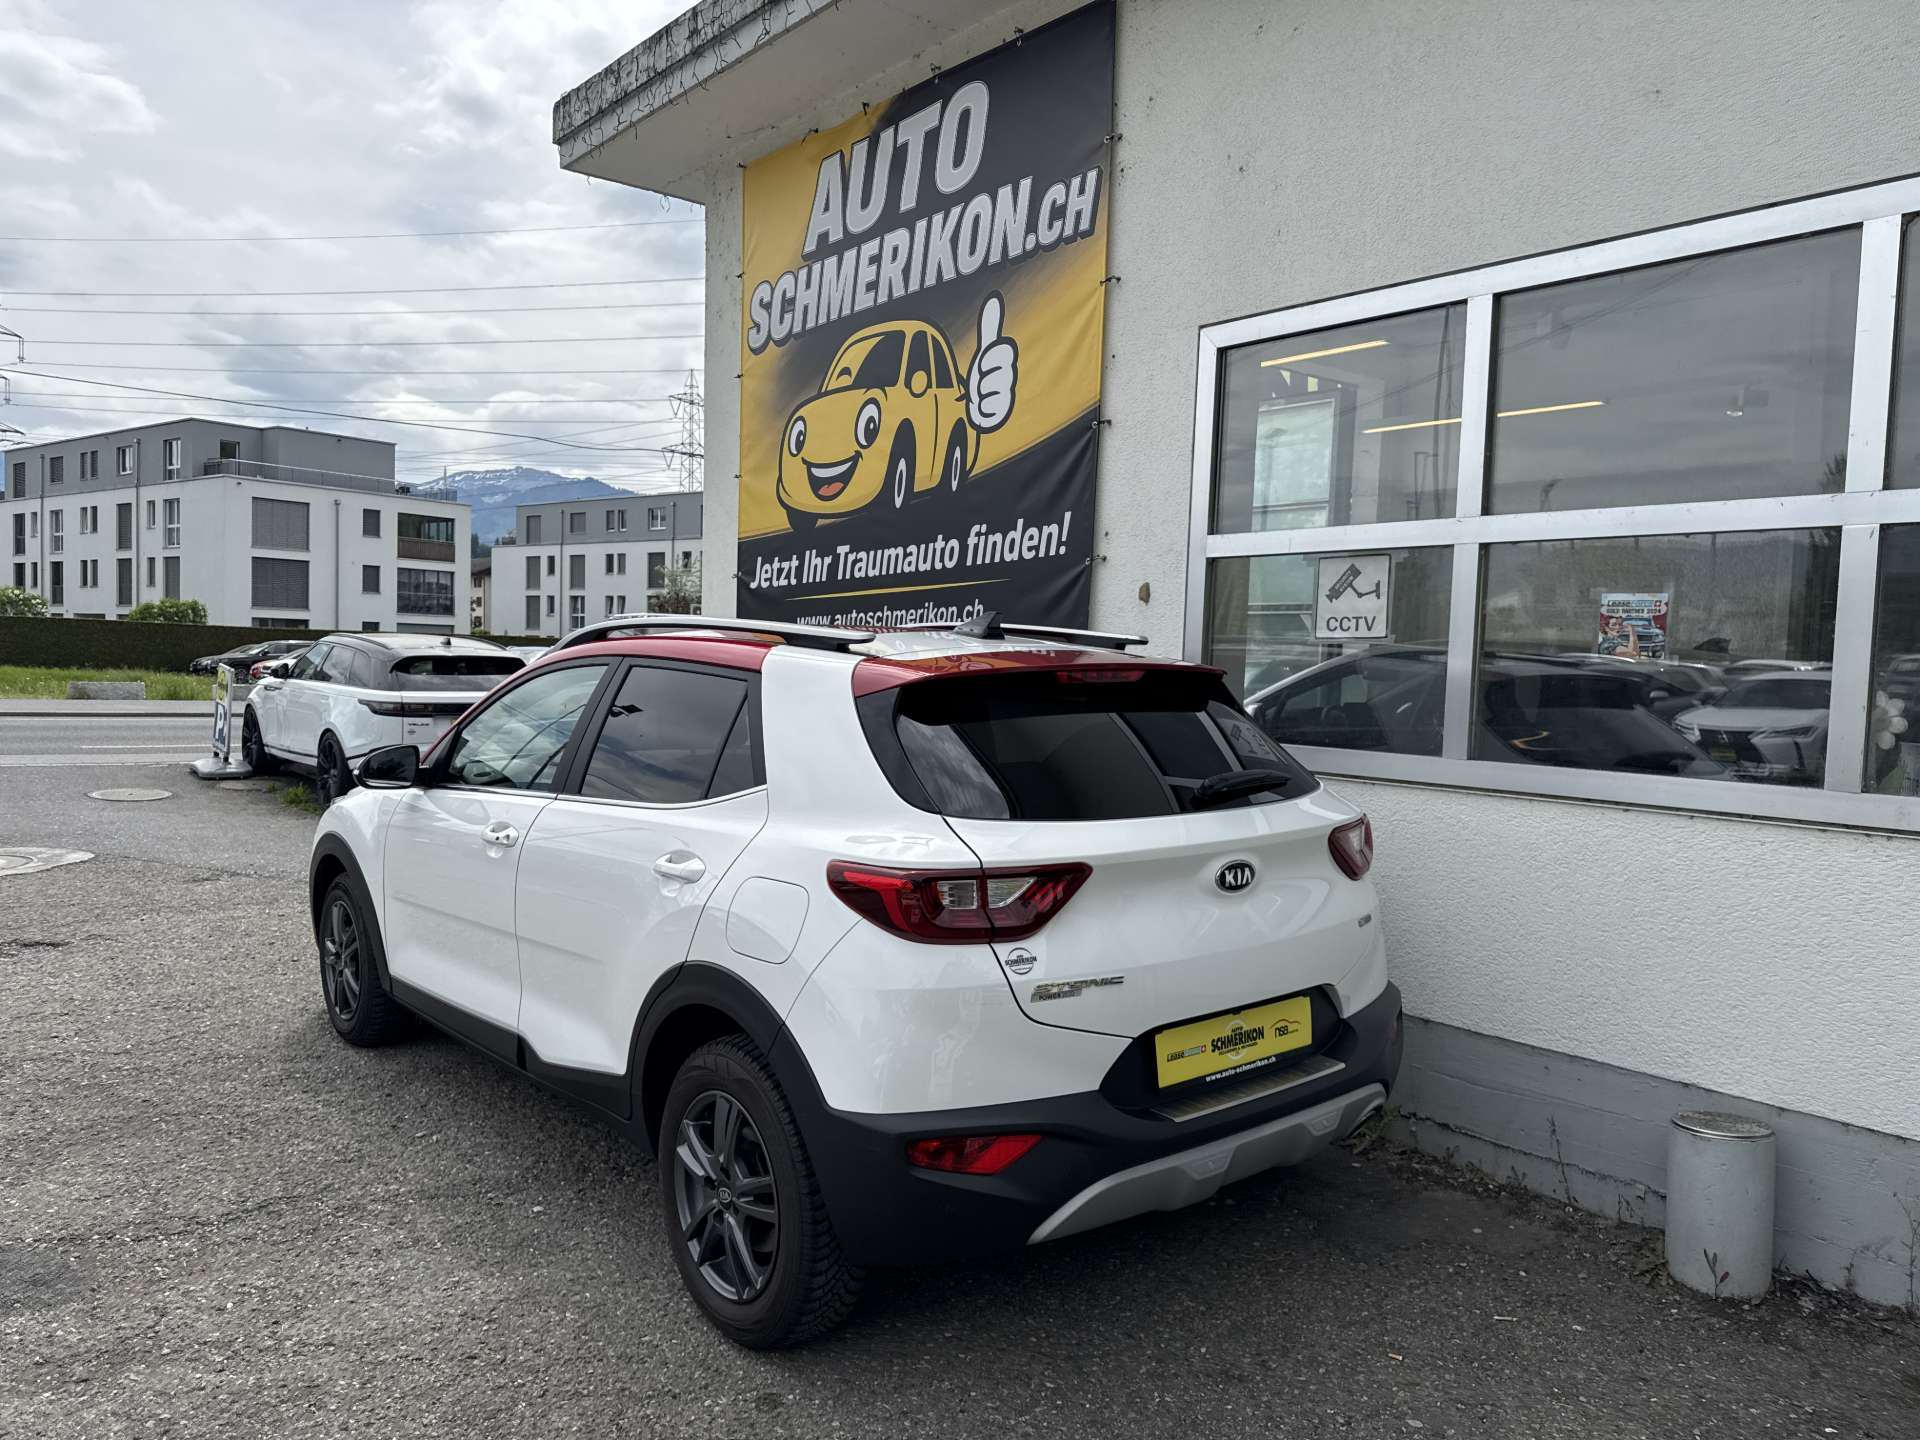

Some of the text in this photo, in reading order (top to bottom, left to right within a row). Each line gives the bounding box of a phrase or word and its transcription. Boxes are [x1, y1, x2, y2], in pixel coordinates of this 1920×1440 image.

[802, 80, 990, 256] AUTO
[747, 167, 1100, 352] SCHMERIKON.CH
[750, 511, 1072, 589] Jetzt Ihr Traumauto finden!
[1326, 616, 1377, 632] CCTV
[1224, 867, 1252, 887] KIA
[1211, 1026, 1265, 1053] SCHMERIKON
